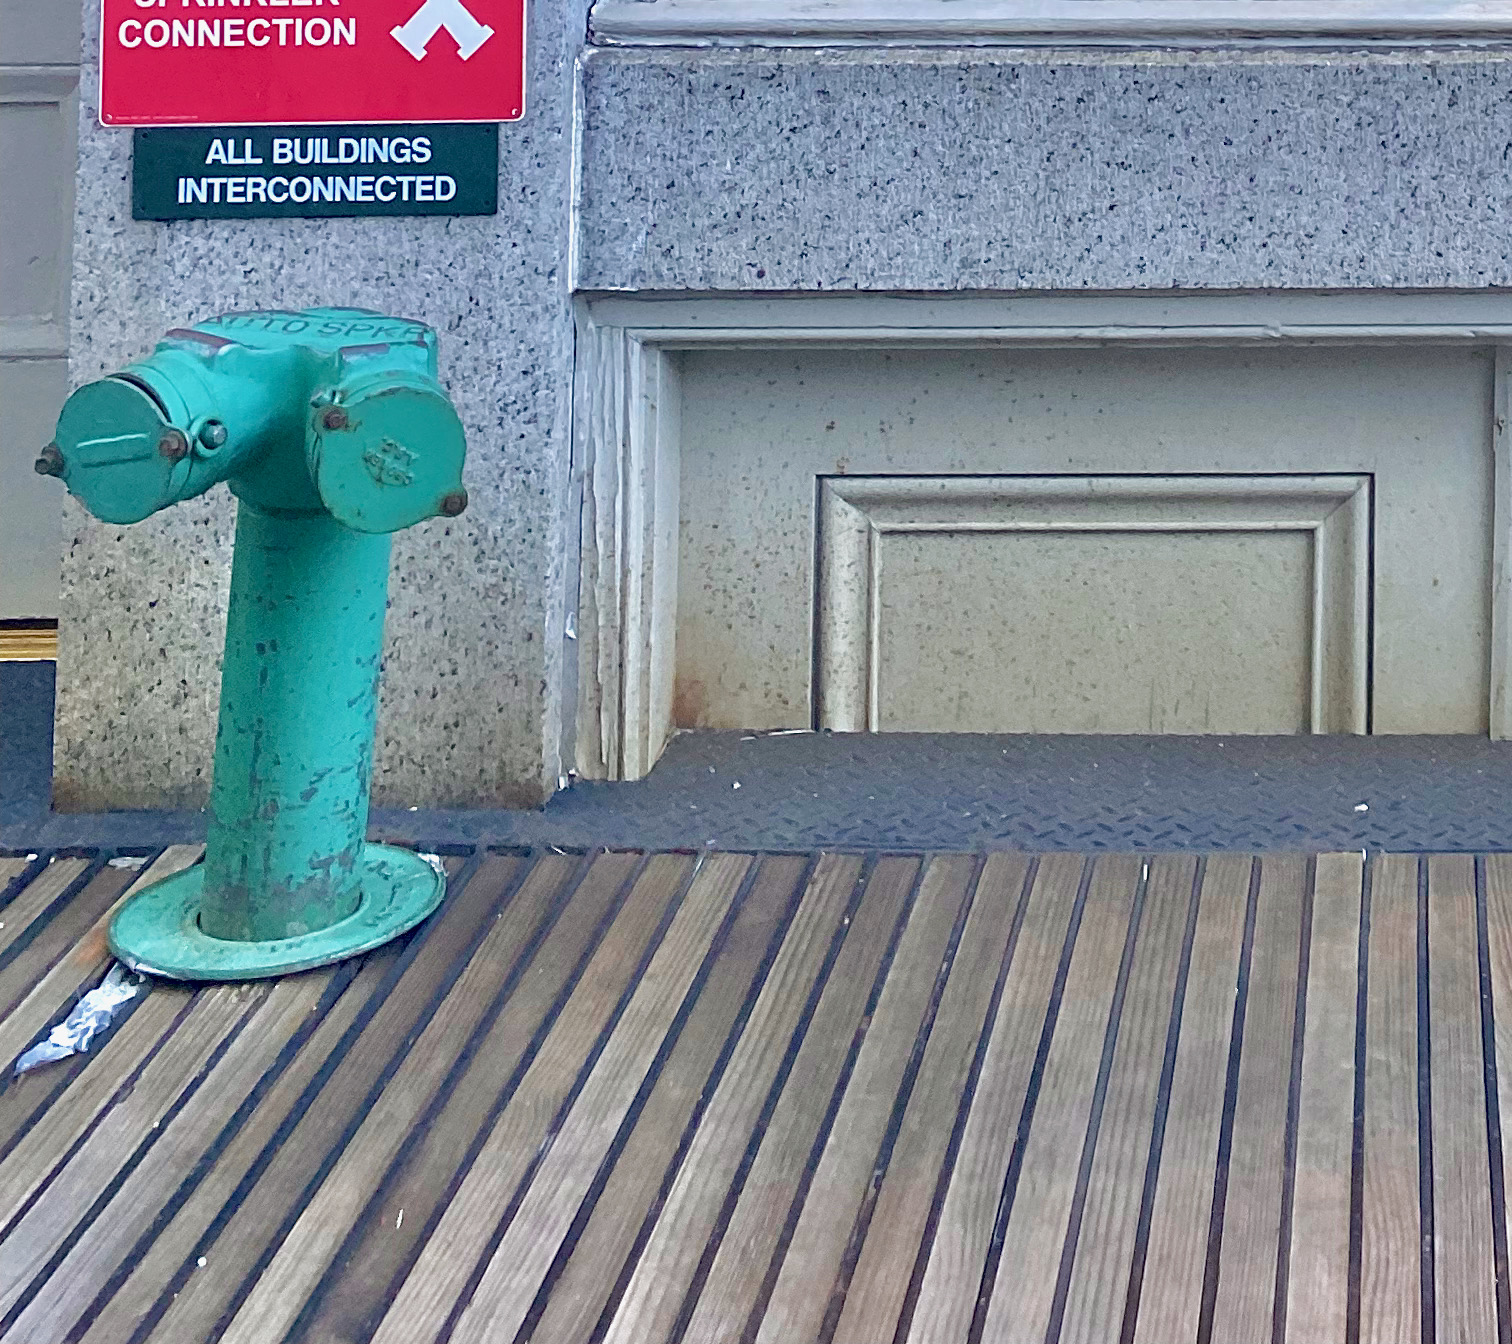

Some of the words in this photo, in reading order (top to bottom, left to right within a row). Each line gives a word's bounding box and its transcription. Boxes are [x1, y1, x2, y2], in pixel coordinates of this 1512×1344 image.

[119, 18, 355, 47] CONNECTION
[205, 139, 263, 164] ALL
[273, 137, 431, 164] BUILDINGS
[179, 176, 457, 203] INTERCONNECTED
